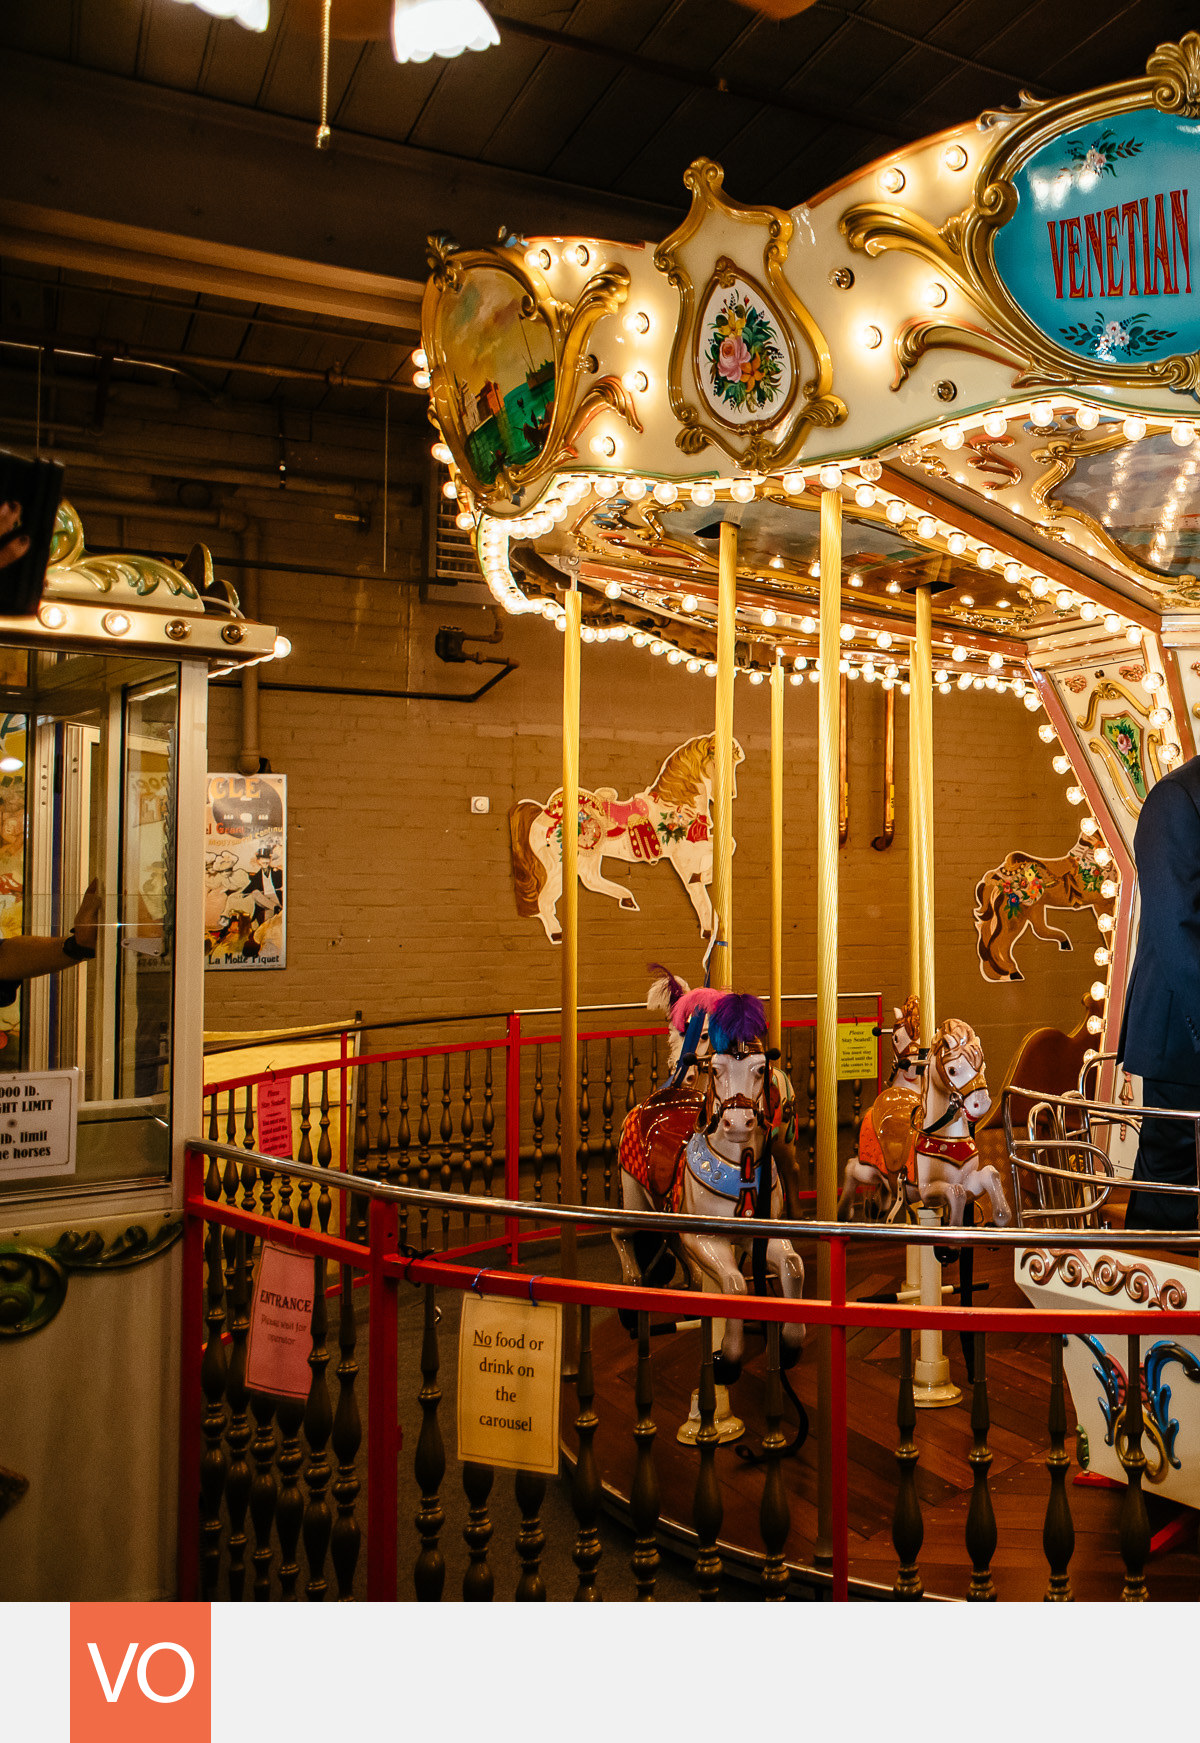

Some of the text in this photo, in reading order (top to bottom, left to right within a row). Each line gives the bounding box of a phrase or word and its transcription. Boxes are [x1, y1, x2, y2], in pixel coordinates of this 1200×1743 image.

[1047, 189, 1192, 300] VENETIAN
[206, 777, 261, 799] CLE
[208, 954, 221, 965] La
[225, 952, 249, 964] Motte
[25, 1085, 39, 1097] lb.
[22, 1100, 53, 1112] LIMIT
[20, 1131, 47, 1143] limit
[13, 1146, 51, 1159] horses
[260, 1289, 312, 1313] ENTRANCE
[473, 1329, 544, 1351] No food or
[479, 1356, 535, 1377] drink on
[495, 1386, 517, 1403] the
[479, 1414, 533, 1432] carousel
